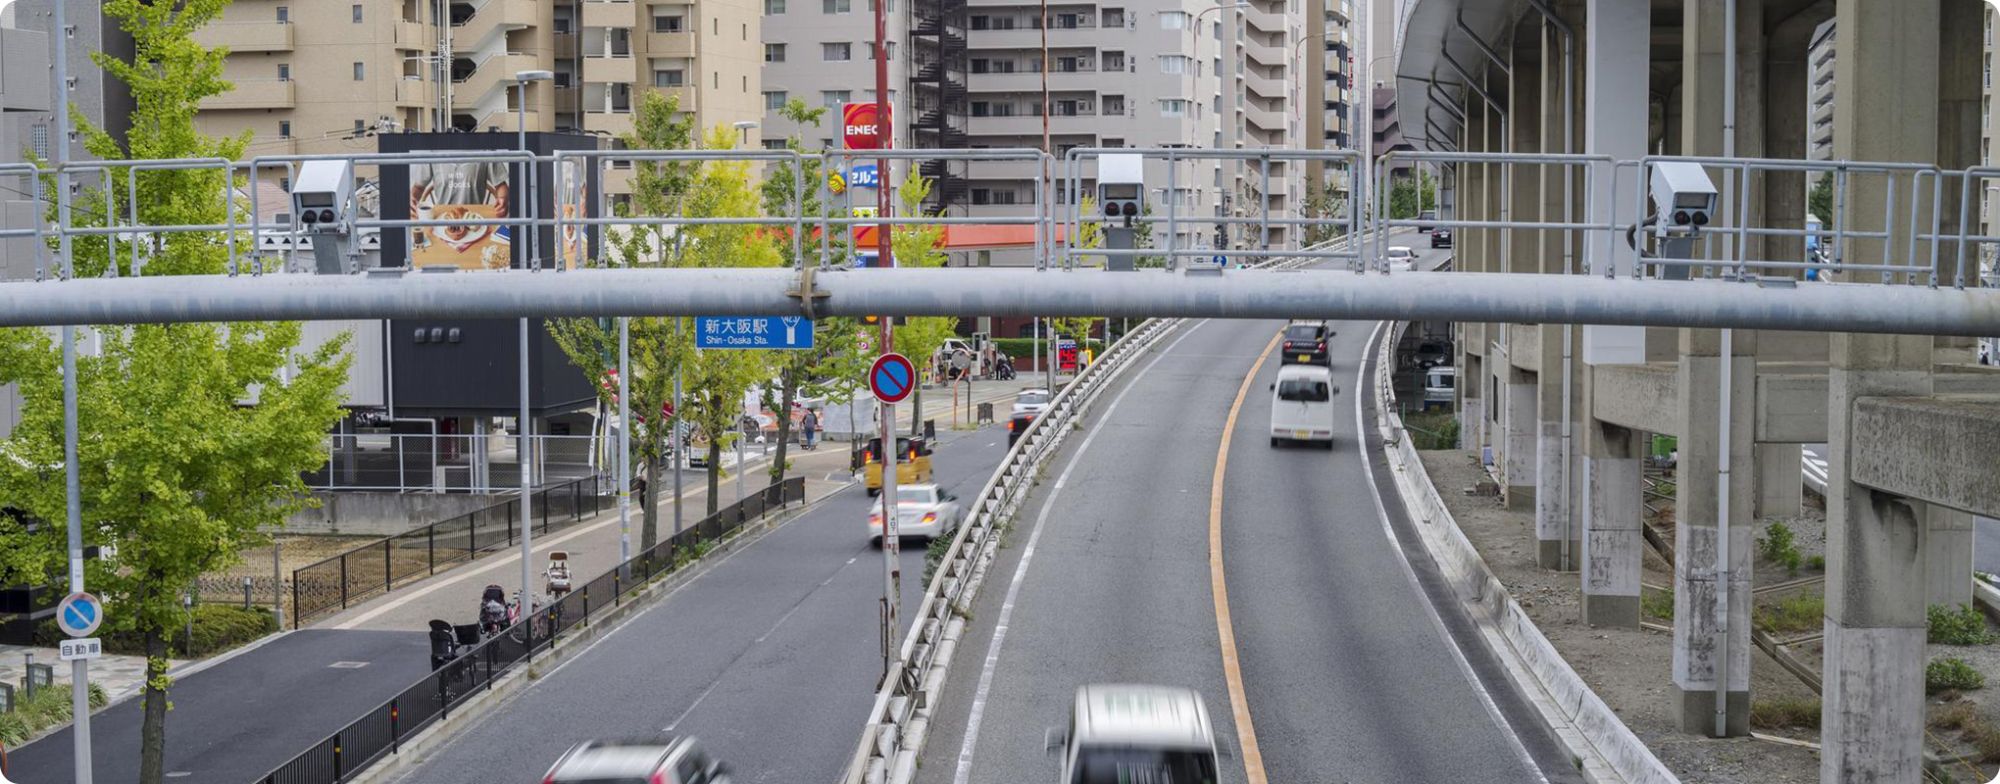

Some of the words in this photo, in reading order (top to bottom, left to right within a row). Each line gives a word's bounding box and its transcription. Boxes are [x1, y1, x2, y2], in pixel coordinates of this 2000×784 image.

[846, 124, 878, 135] ENEO
[705, 319, 768, 334] 新大阪駅
[706, 336, 752, 345] Shin-Osaka
[754, 336, 768, 344] Sta.
[62, 643, 99, 656] 自動車
